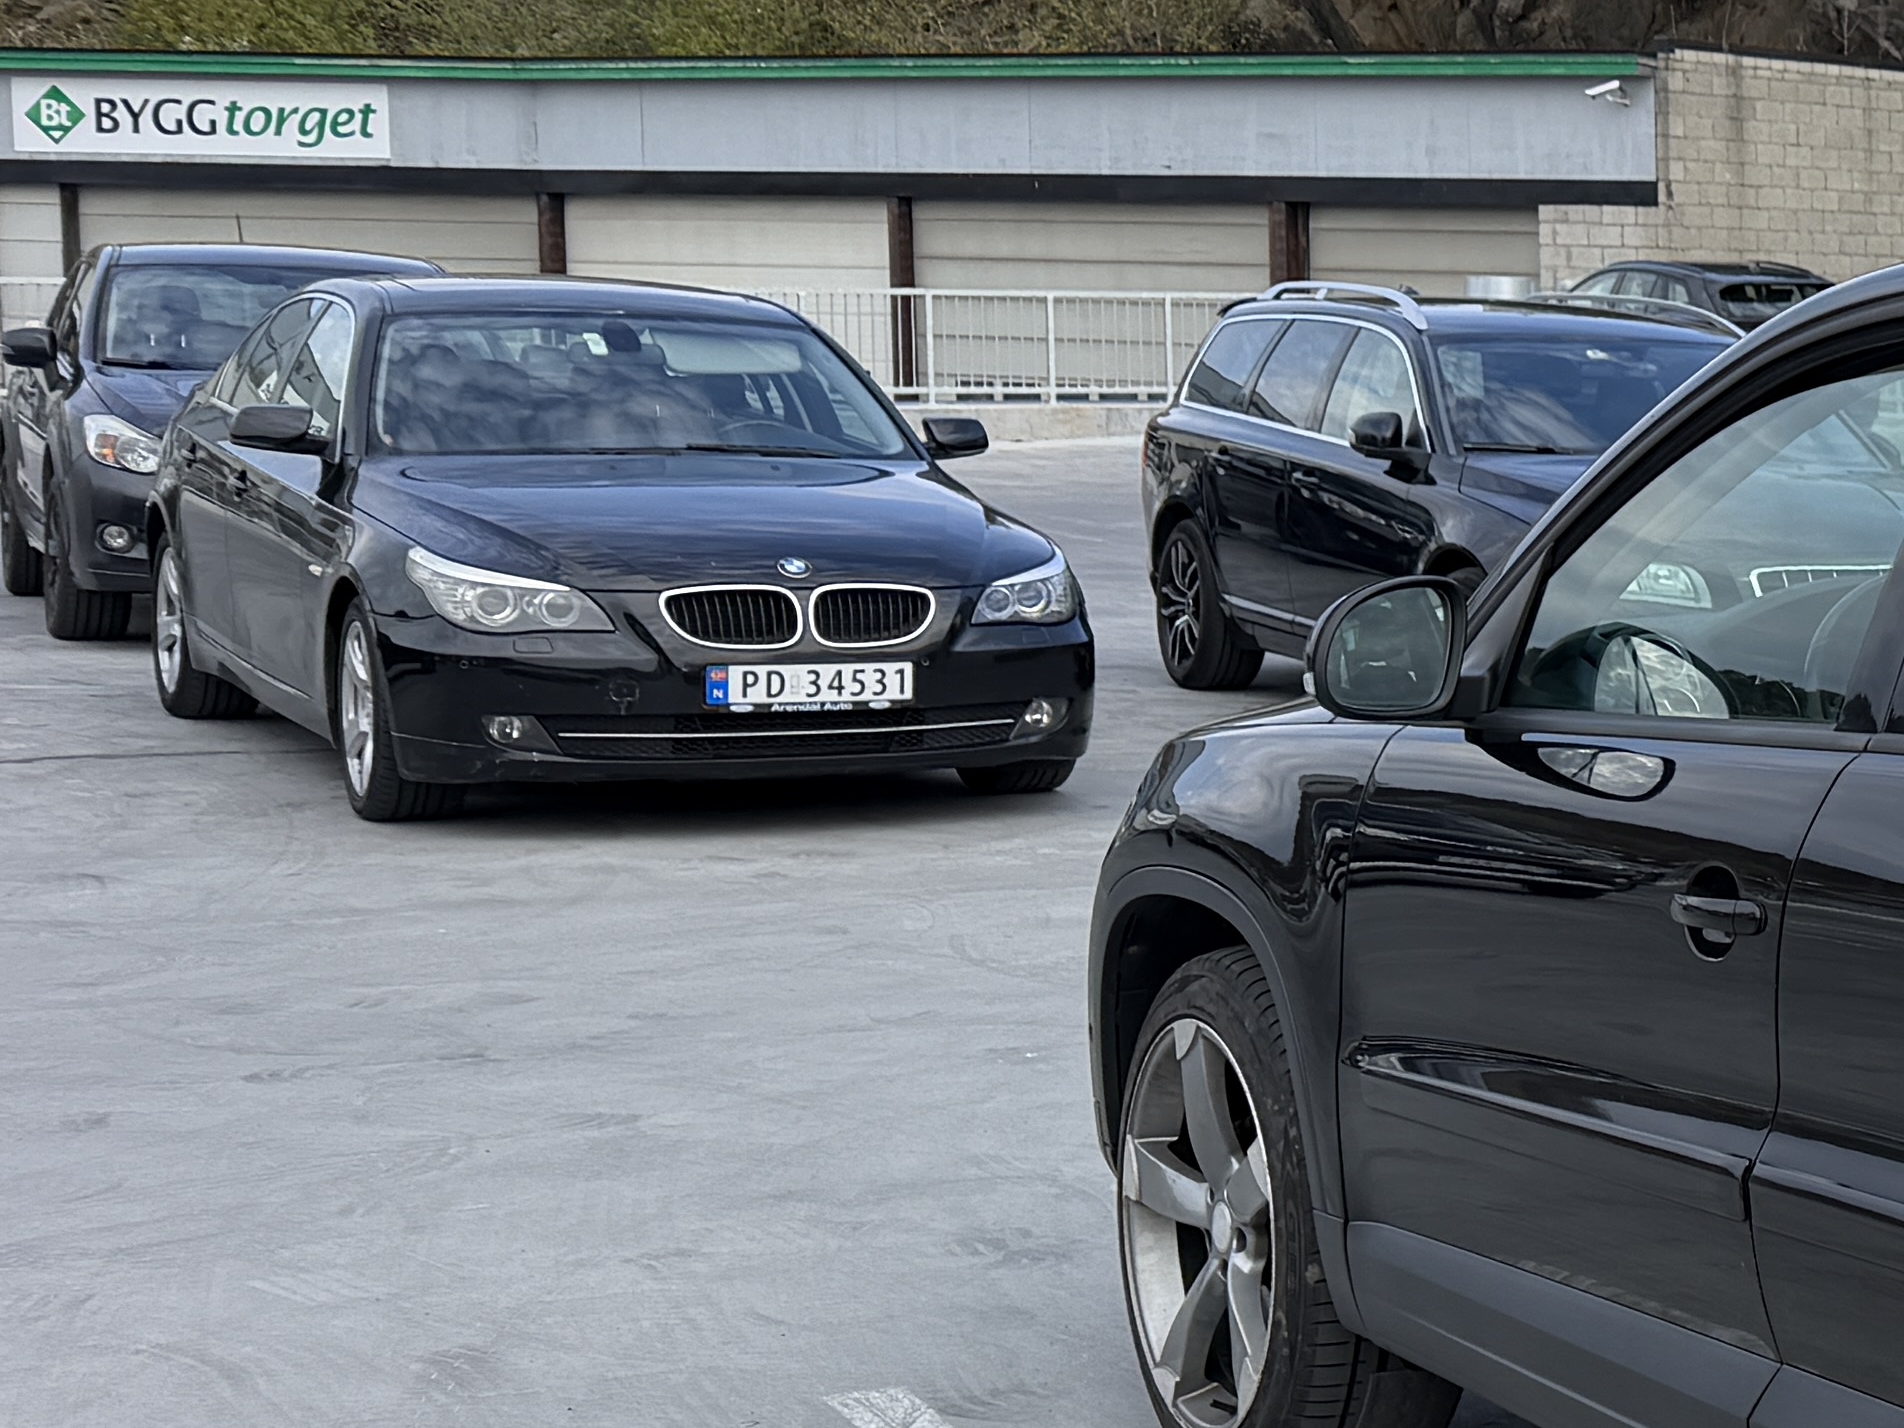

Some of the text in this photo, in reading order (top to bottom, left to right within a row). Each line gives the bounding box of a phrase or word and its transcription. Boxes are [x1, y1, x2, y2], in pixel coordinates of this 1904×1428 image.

[93, 97, 377, 147] BYGGtorget
[713, 688, 724, 699] N
[742, 668, 906, 698] PD 34531
